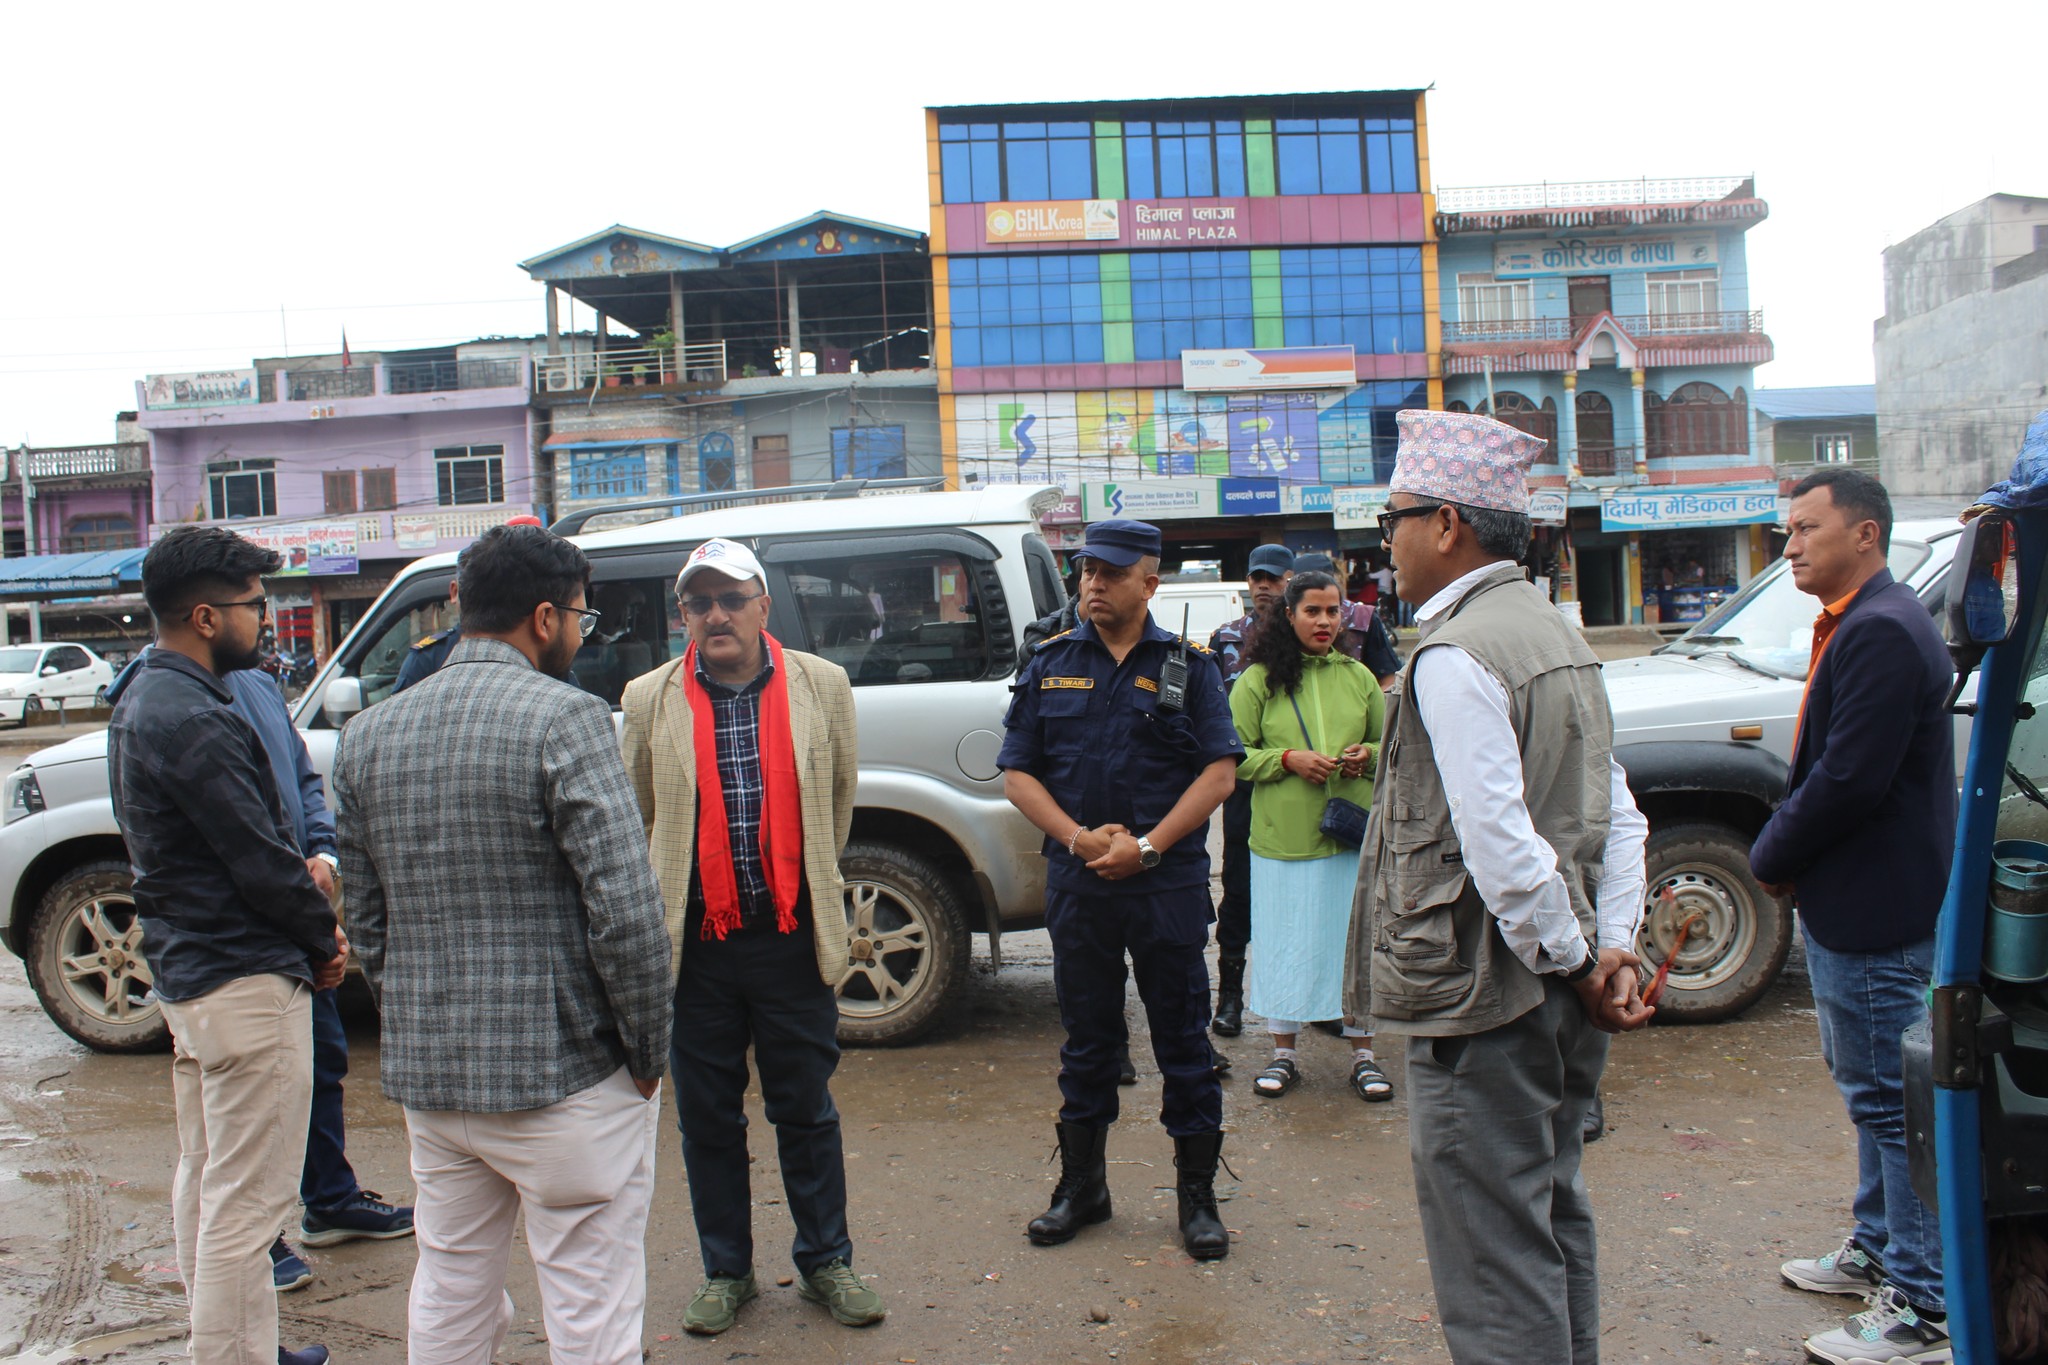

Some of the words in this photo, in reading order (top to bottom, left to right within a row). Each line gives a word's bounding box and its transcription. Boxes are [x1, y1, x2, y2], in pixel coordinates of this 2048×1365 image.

[1136, 204, 1183, 223] हिमाल
[1192, 206, 1235, 221] प्लाजा
[1136, 228, 1181, 241] HIMAL
[1188, 226, 1237, 240] PLAZA
[1541, 239, 1624, 268] कोरियन
[1631, 241, 1675, 264] भाषा
[976, 474, 996, 483] ामना
[1014, 472, 1039, 482] िकास
[1225, 490, 1253, 500] दलदले
[1255, 490, 1276, 500] शाखा
[1303, 493, 1333, 506] ATM
[1603, 497, 1662, 520] दिर्घायू
[1665, 495, 1738, 514] मेडिकल
[1744, 494, 1776, 511] हल
[1059, 679, 1086, 687] TIWARI
